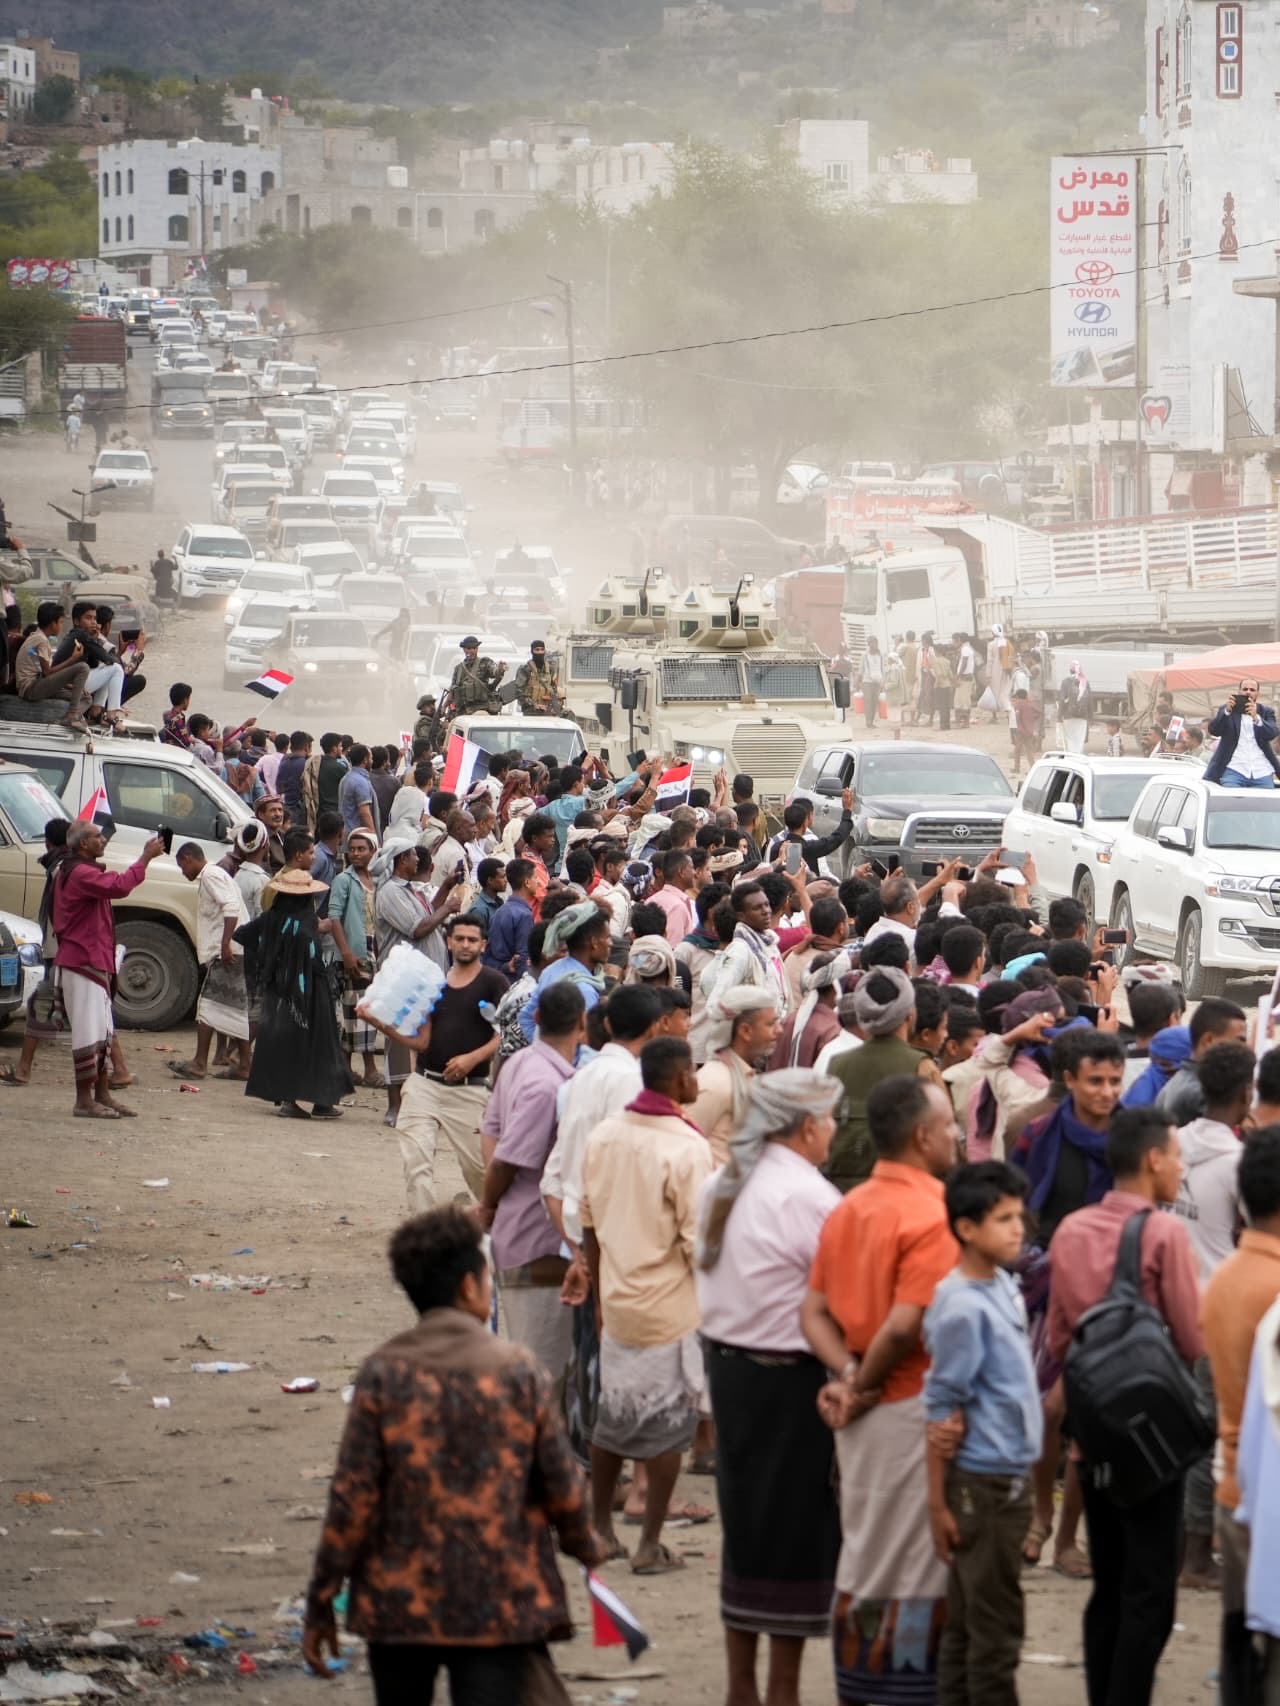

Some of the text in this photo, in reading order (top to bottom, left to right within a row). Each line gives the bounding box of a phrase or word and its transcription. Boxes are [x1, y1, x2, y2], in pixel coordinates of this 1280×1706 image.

[1059, 166, 1129, 190] معرض
[1057, 194, 1130, 224] قدس
[1068, 288, 1120, 298] TOYOTA
[1067, 327, 1118, 337] HYUNDAI
